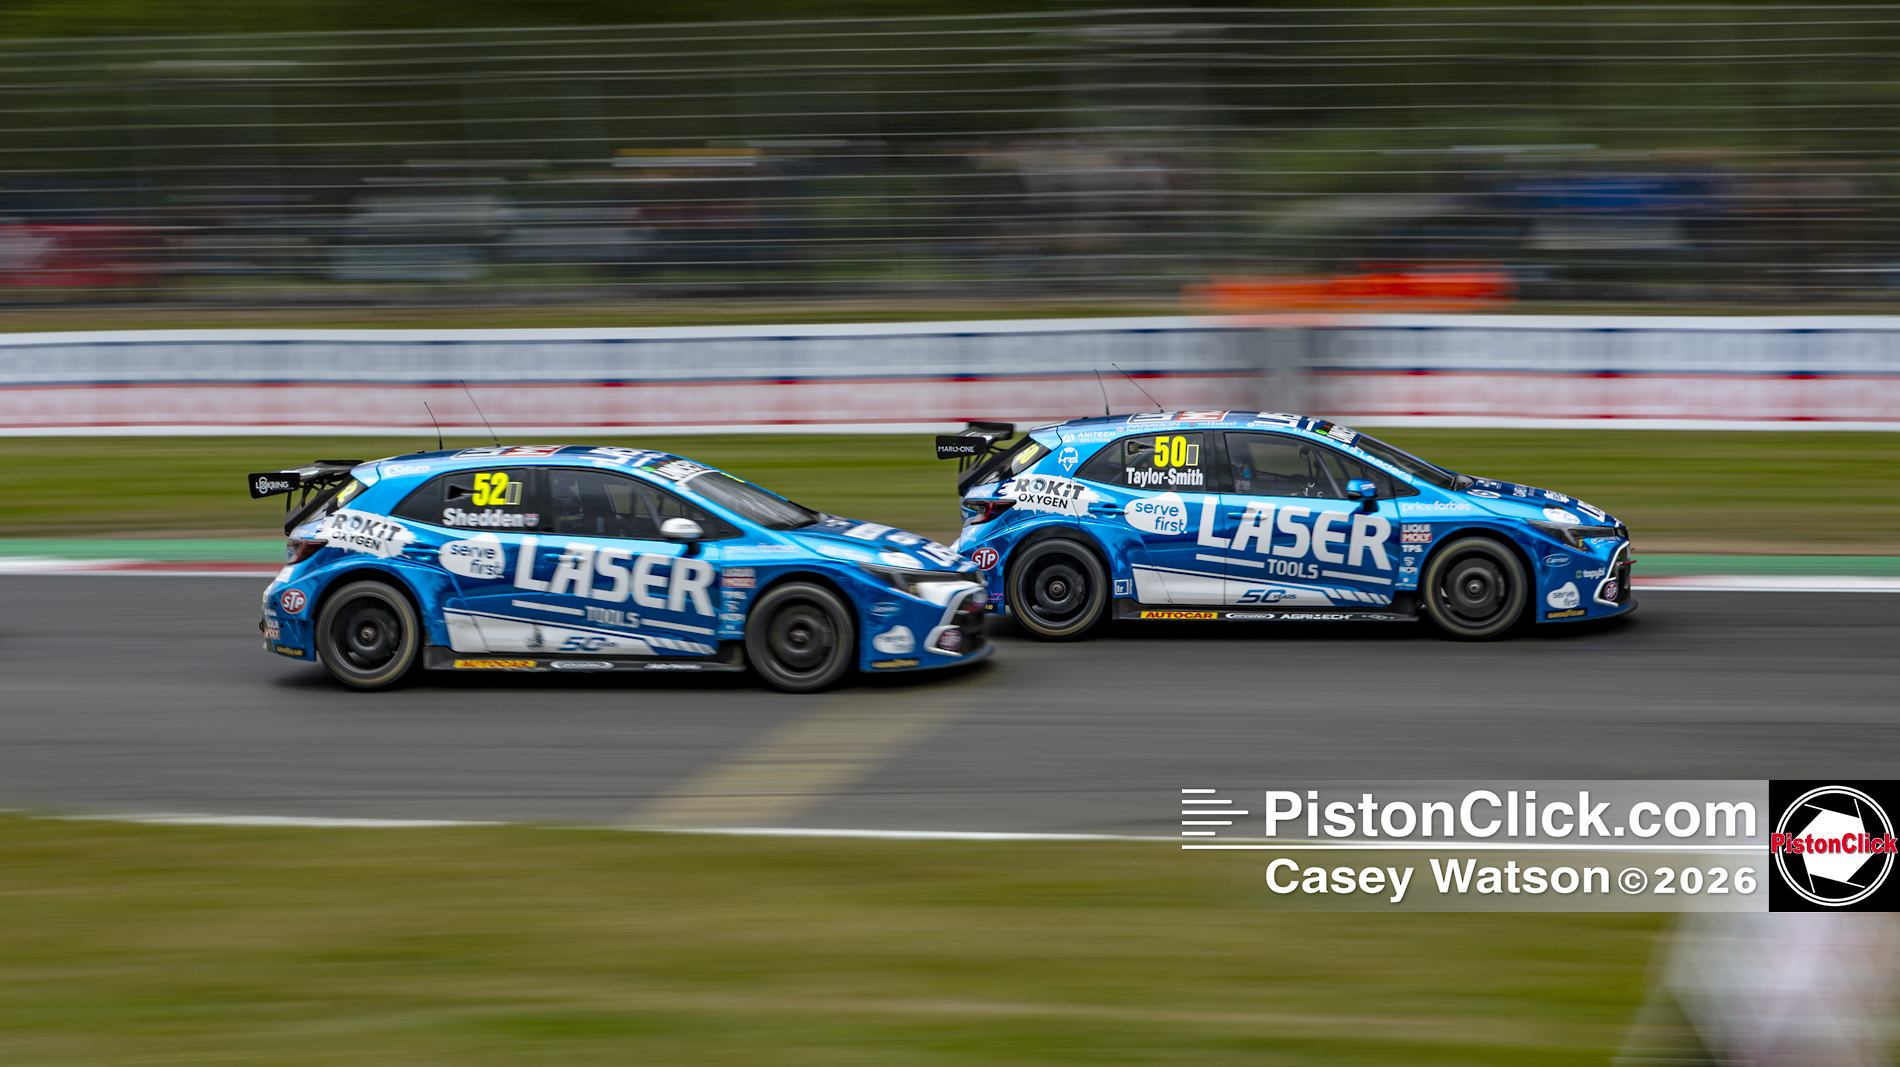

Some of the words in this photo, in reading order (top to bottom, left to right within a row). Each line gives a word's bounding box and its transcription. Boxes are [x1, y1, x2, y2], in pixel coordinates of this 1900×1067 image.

[1154, 435, 1187, 467] 50
[1126, 467, 1204, 488] Taylor-Smith
[471, 472, 510, 507] 52
[1018, 492, 1069, 510] OXYGEN
[1134, 501, 1179, 517] serve
[442, 507, 525, 528] Shedden
[1196, 495, 1393, 571] LASER
[1402, 524, 1431, 532] LIQUI
[1402, 533, 1431, 542] MOLY
[331, 530, 383, 551] OXYGEN
[450, 542, 496, 560] serve
[974, 549, 996, 569] STP
[513, 535, 717, 617] LASER
[1266, 559, 1319, 579] TOOLS
[1552, 591, 1576, 599] serve
[1606, 583, 1617, 599] STP
[282, 591, 305, 612] STP
[1145, 611, 1213, 619] AUTOCAR
